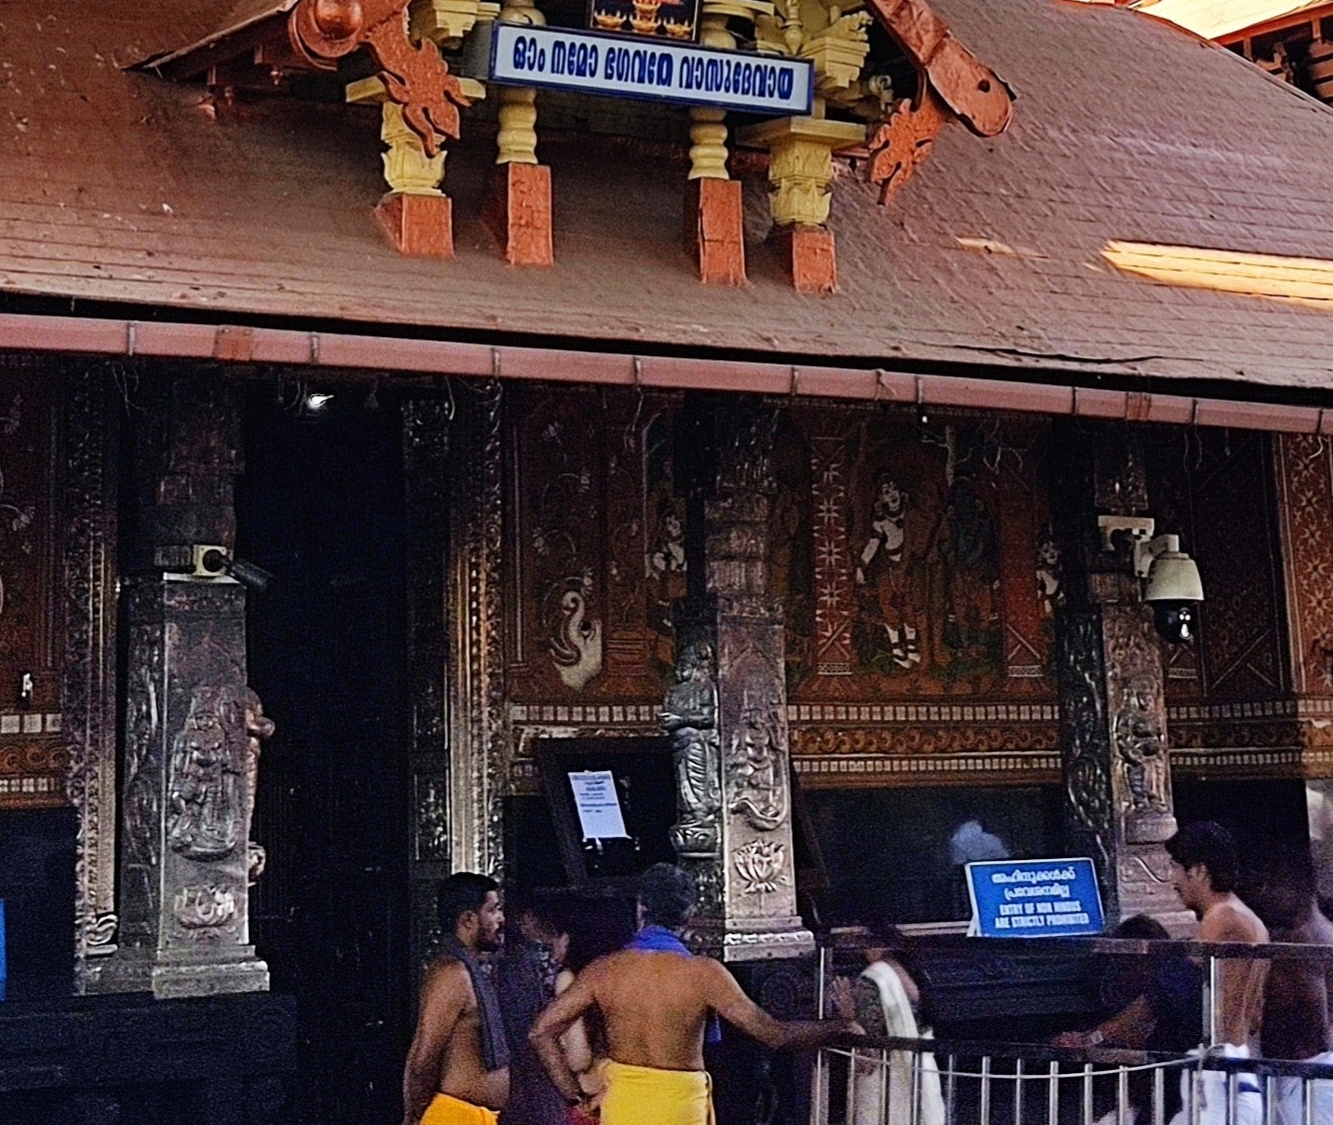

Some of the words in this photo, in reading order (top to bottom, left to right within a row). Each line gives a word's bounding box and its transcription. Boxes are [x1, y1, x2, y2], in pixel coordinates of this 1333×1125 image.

[513, 36, 546, 72] ഓം
[550, 40, 598, 78] നമോ
[604, 47, 674, 88] ഭഗവതേ
[678, 55, 794, 101] വാസുദേവായ
